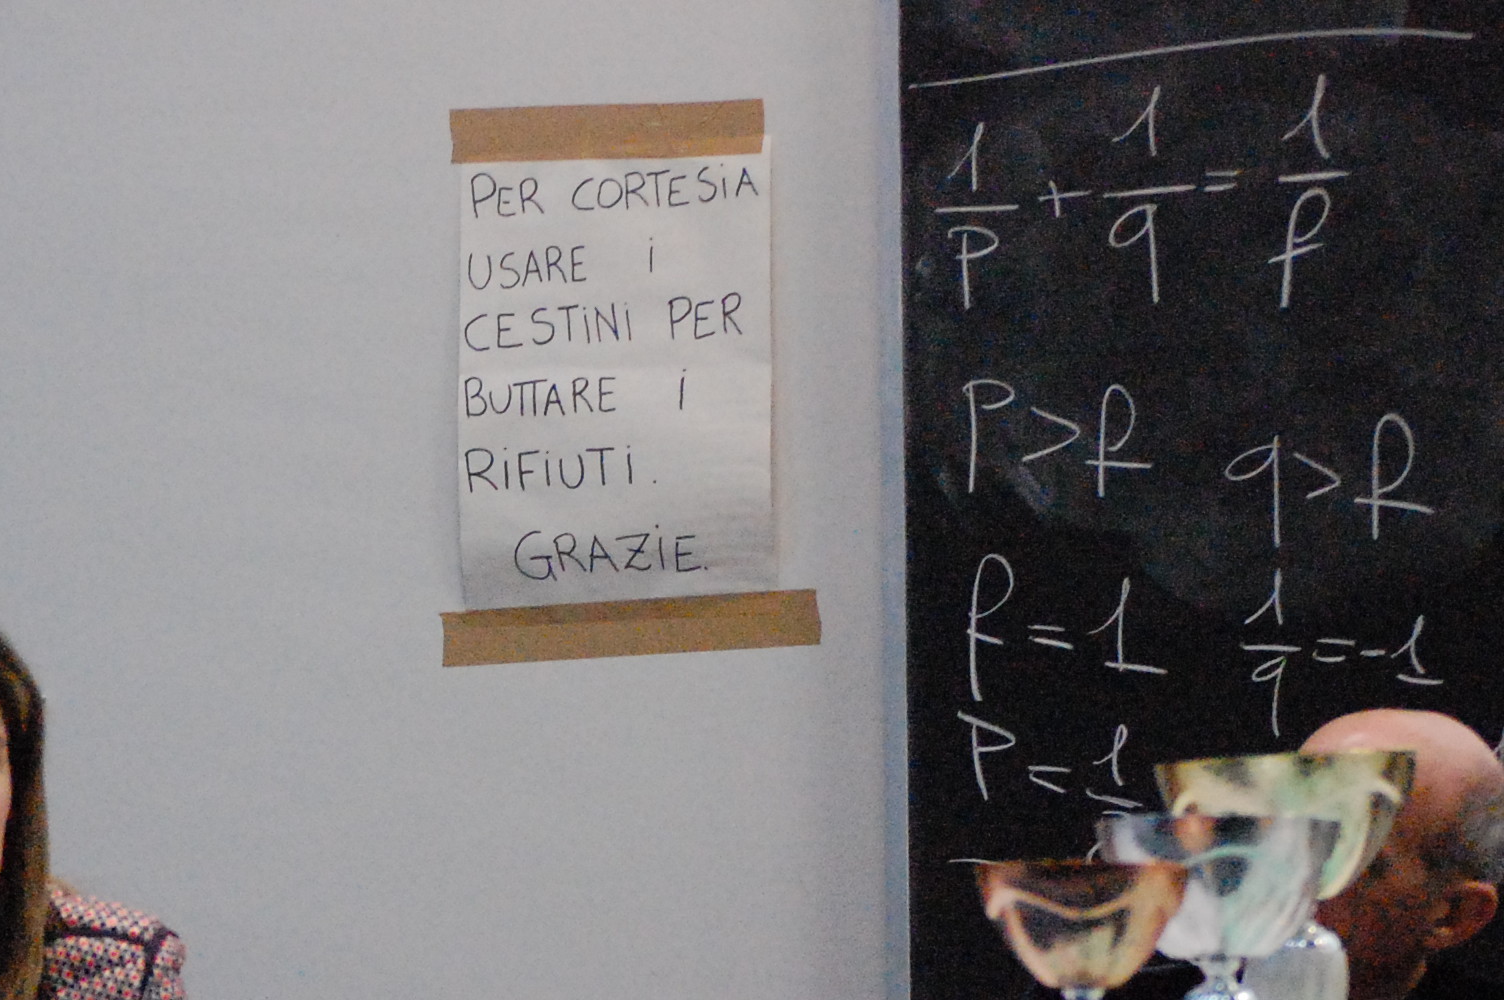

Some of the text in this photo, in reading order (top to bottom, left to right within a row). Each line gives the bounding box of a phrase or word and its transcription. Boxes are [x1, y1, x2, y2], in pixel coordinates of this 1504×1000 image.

[470, 172, 545, 218] PER
[468, 245, 588, 290] USARE
[668, 292, 743, 340] PER
[464, 376, 617, 418] BUTTARE
